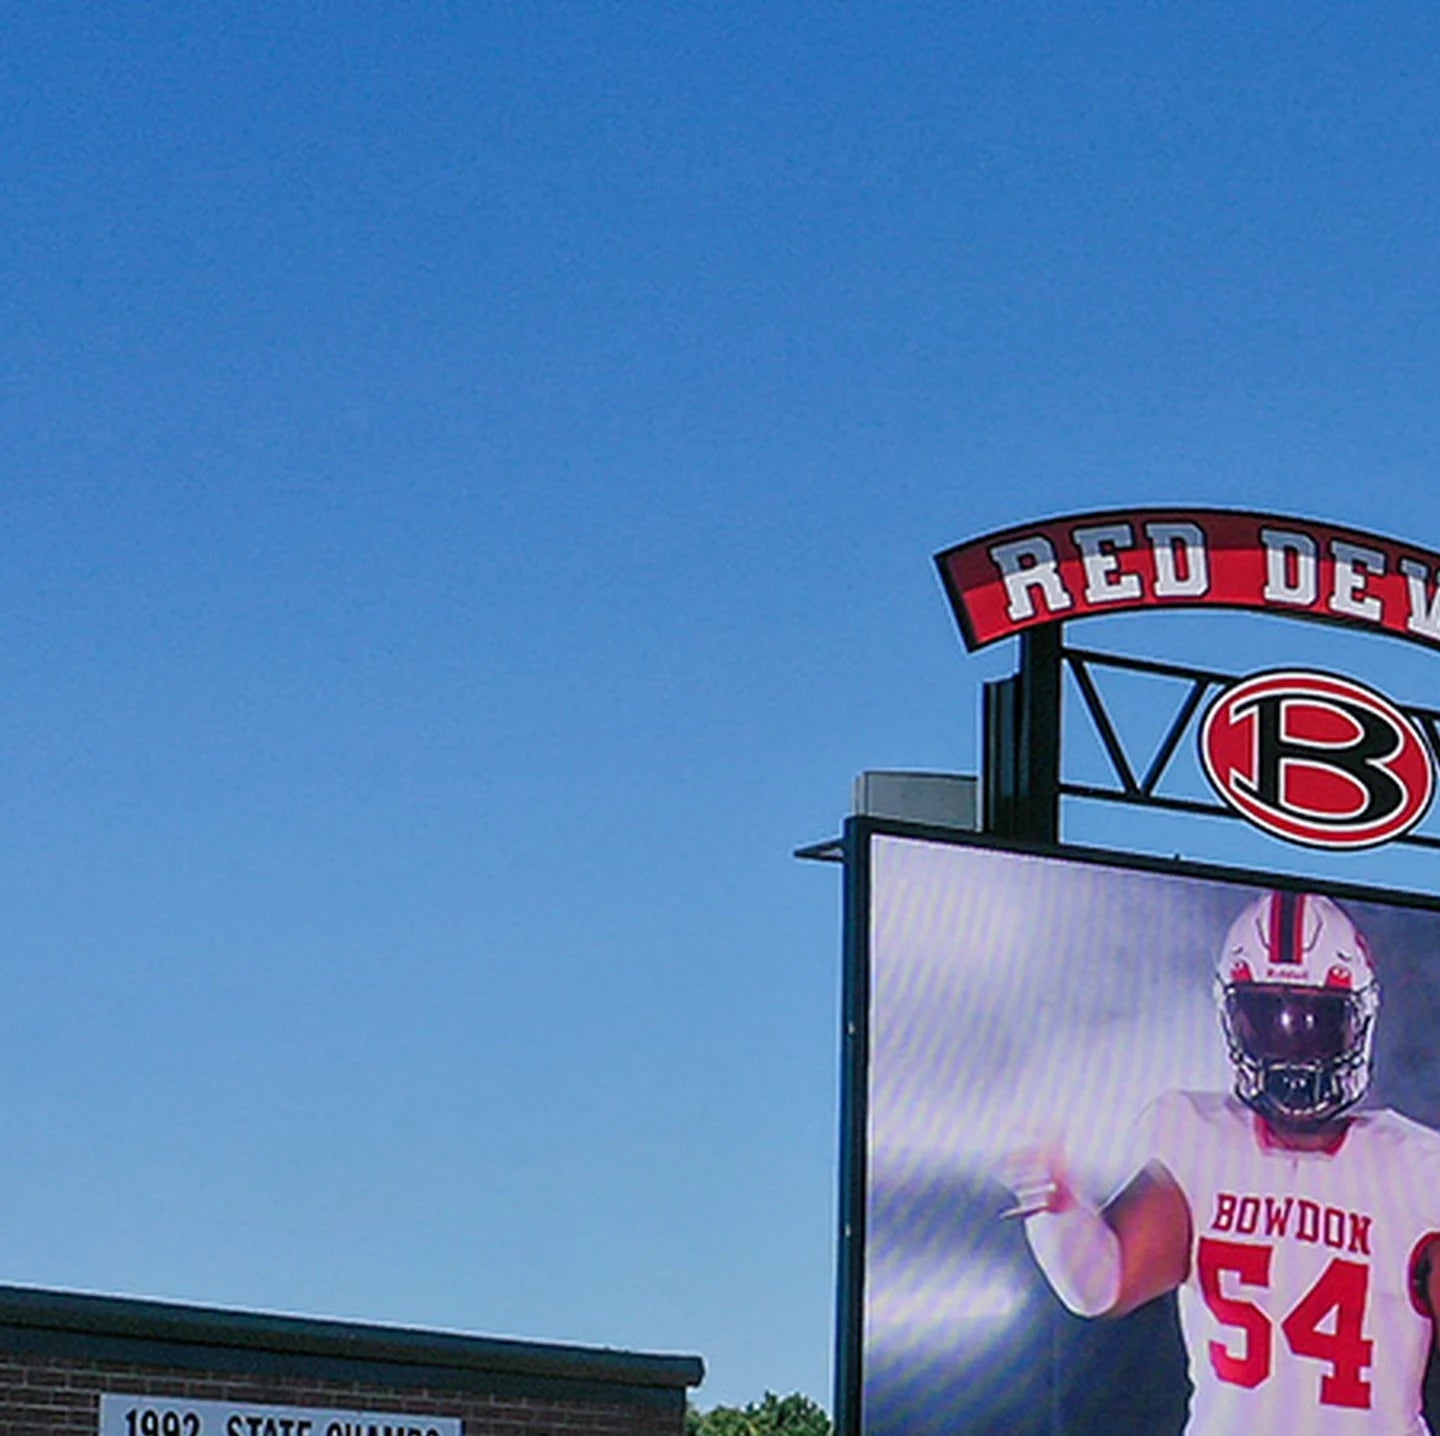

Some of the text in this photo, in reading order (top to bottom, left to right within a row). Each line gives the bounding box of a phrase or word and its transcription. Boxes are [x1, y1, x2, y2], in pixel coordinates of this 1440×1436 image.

[990, 520, 1209, 620] RED
[1230, 692, 1408, 826] B
[1212, 1193, 1373, 1255] BOWDON
[1199, 1237, 1374, 1409] 54
